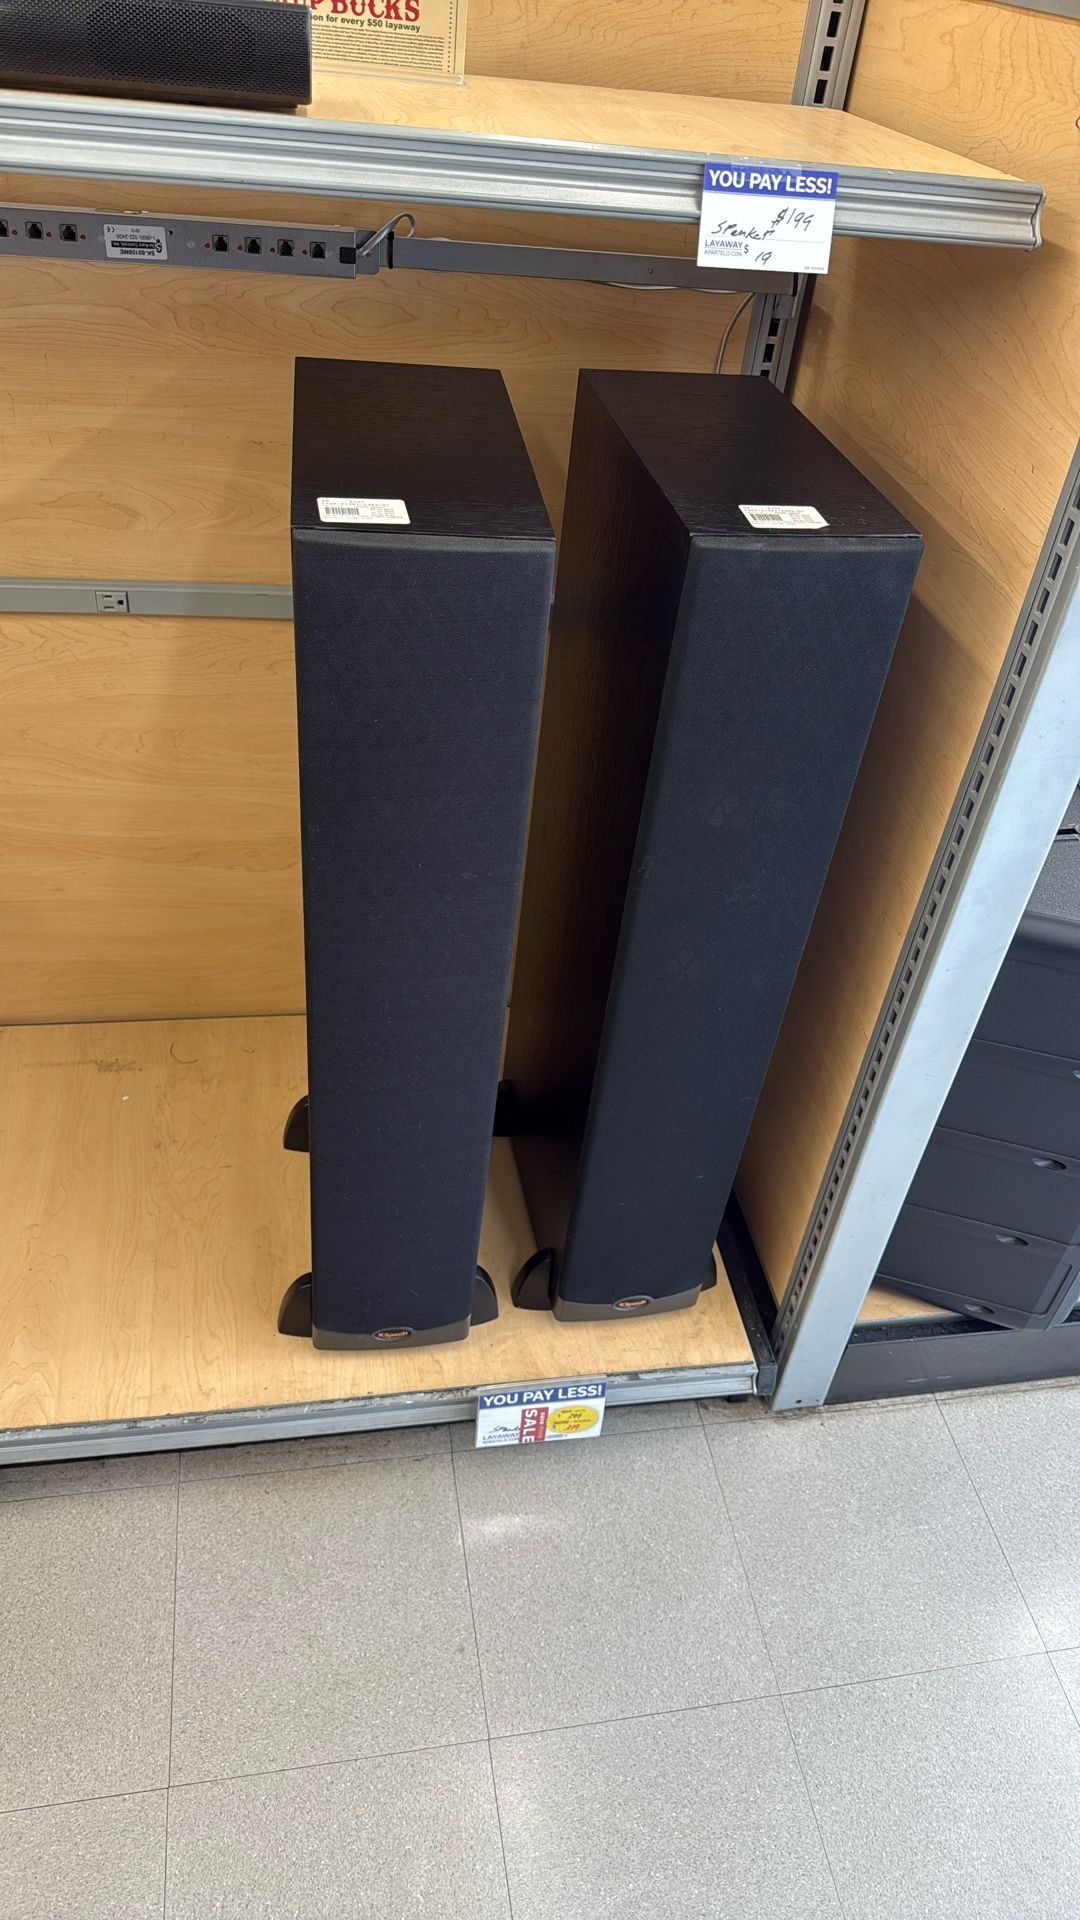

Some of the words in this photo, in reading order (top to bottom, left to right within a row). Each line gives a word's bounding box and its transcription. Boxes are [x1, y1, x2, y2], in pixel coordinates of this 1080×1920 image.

[331, 0, 420, 22] BUCKS
[326, 14, 339, 23] for
[341, 17, 365, 28] every
[367, 17, 383, 28] $50
[385, 20, 421, 33] layaway
[709, 169, 746, 188] YOU
[749, 172, 783, 191] PAY
[785, 175, 833, 194] LESS!
[704, 239, 743, 249] LAYAWAY
[483, 1393, 518, 1406] YOU
[523, 1389, 554, 1402] PAY
[558, 1385, 602, 1399] LESS!
[522, 1409, 538, 1443] SALE
